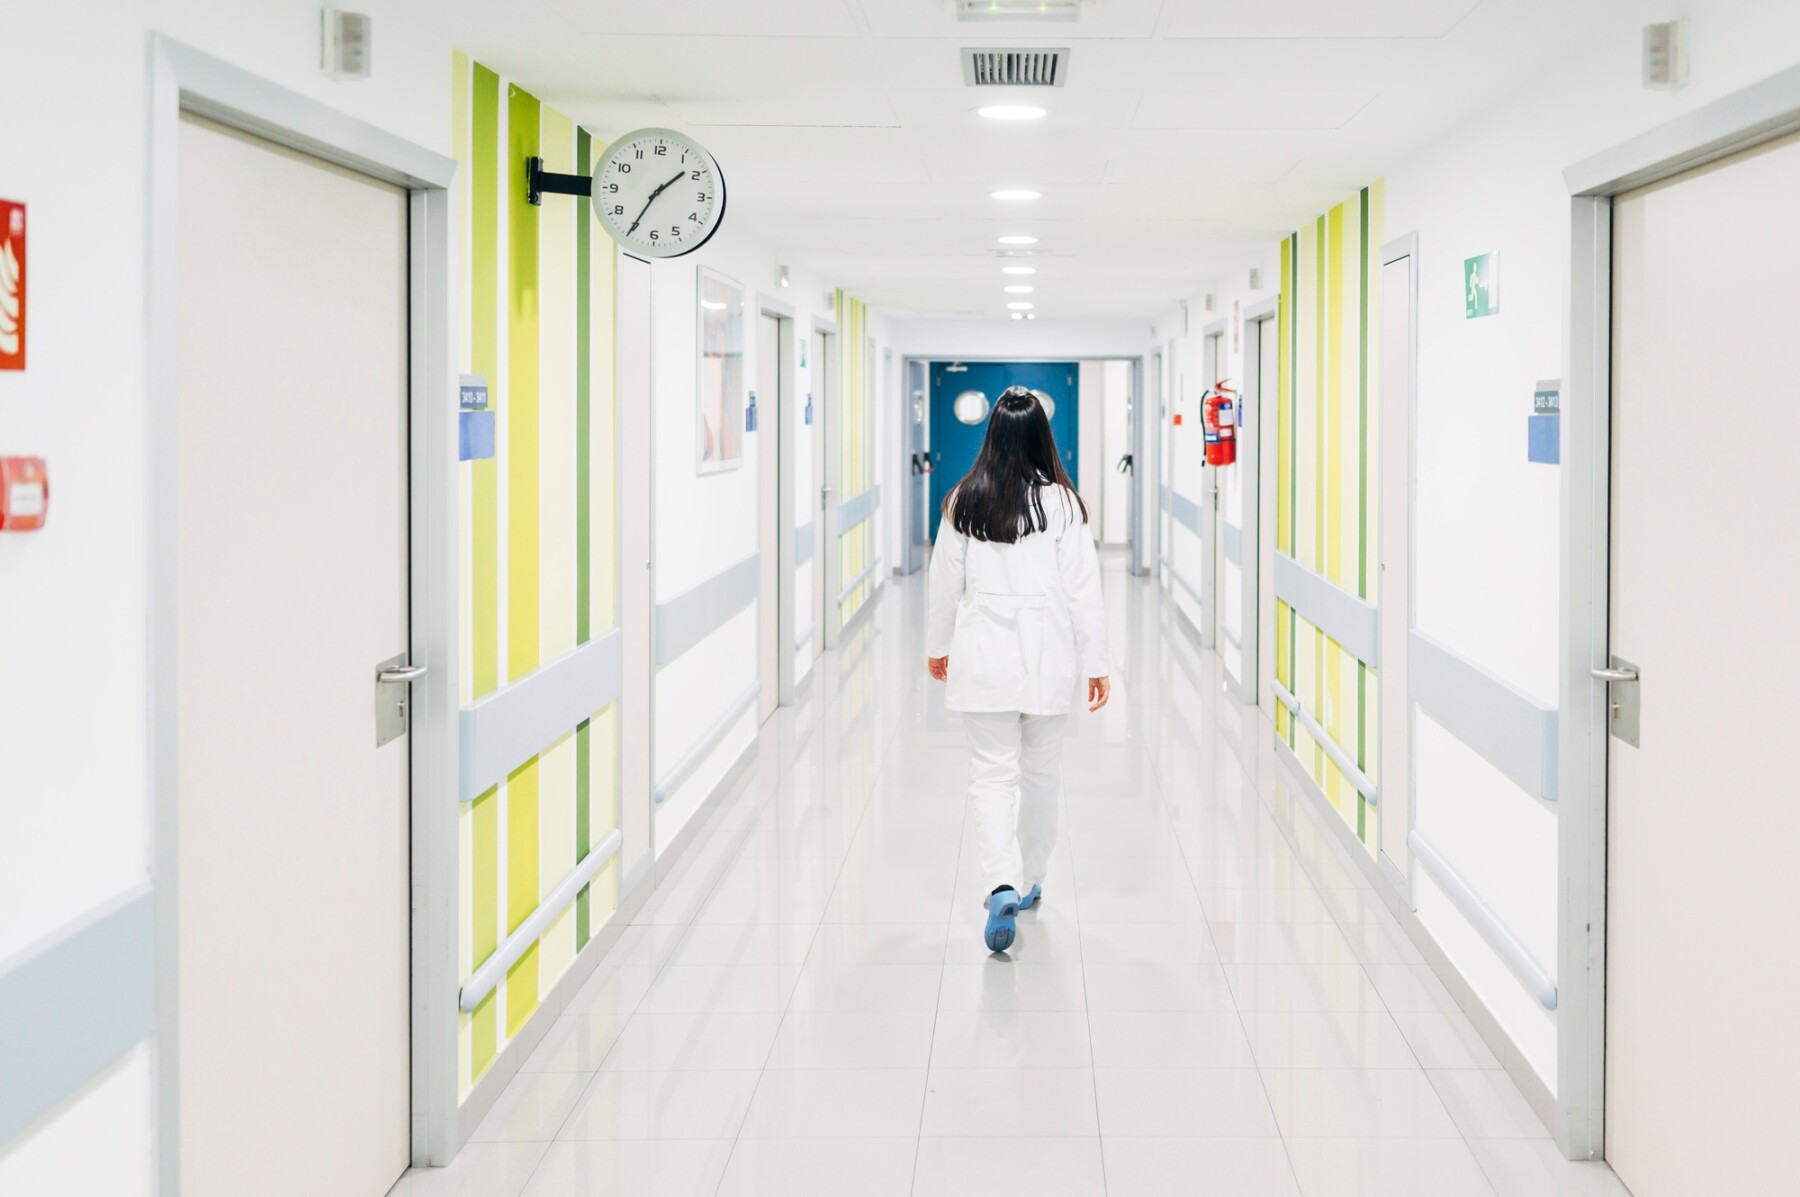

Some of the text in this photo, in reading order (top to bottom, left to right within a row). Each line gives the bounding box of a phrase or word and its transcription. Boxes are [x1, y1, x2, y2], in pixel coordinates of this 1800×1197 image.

[636, 150, 644, 159] 11
[654, 145, 667, 156] 12
[618, 163, 631, 174] 10
[691, 170, 701, 181] 2
[609, 183, 619, 193] 9
[697, 192, 706, 202] 3
[614, 205, 624, 215] 8
[688, 212, 698, 222] 4
[649, 230, 659, 240] 6
[671, 226, 681, 236] 5
